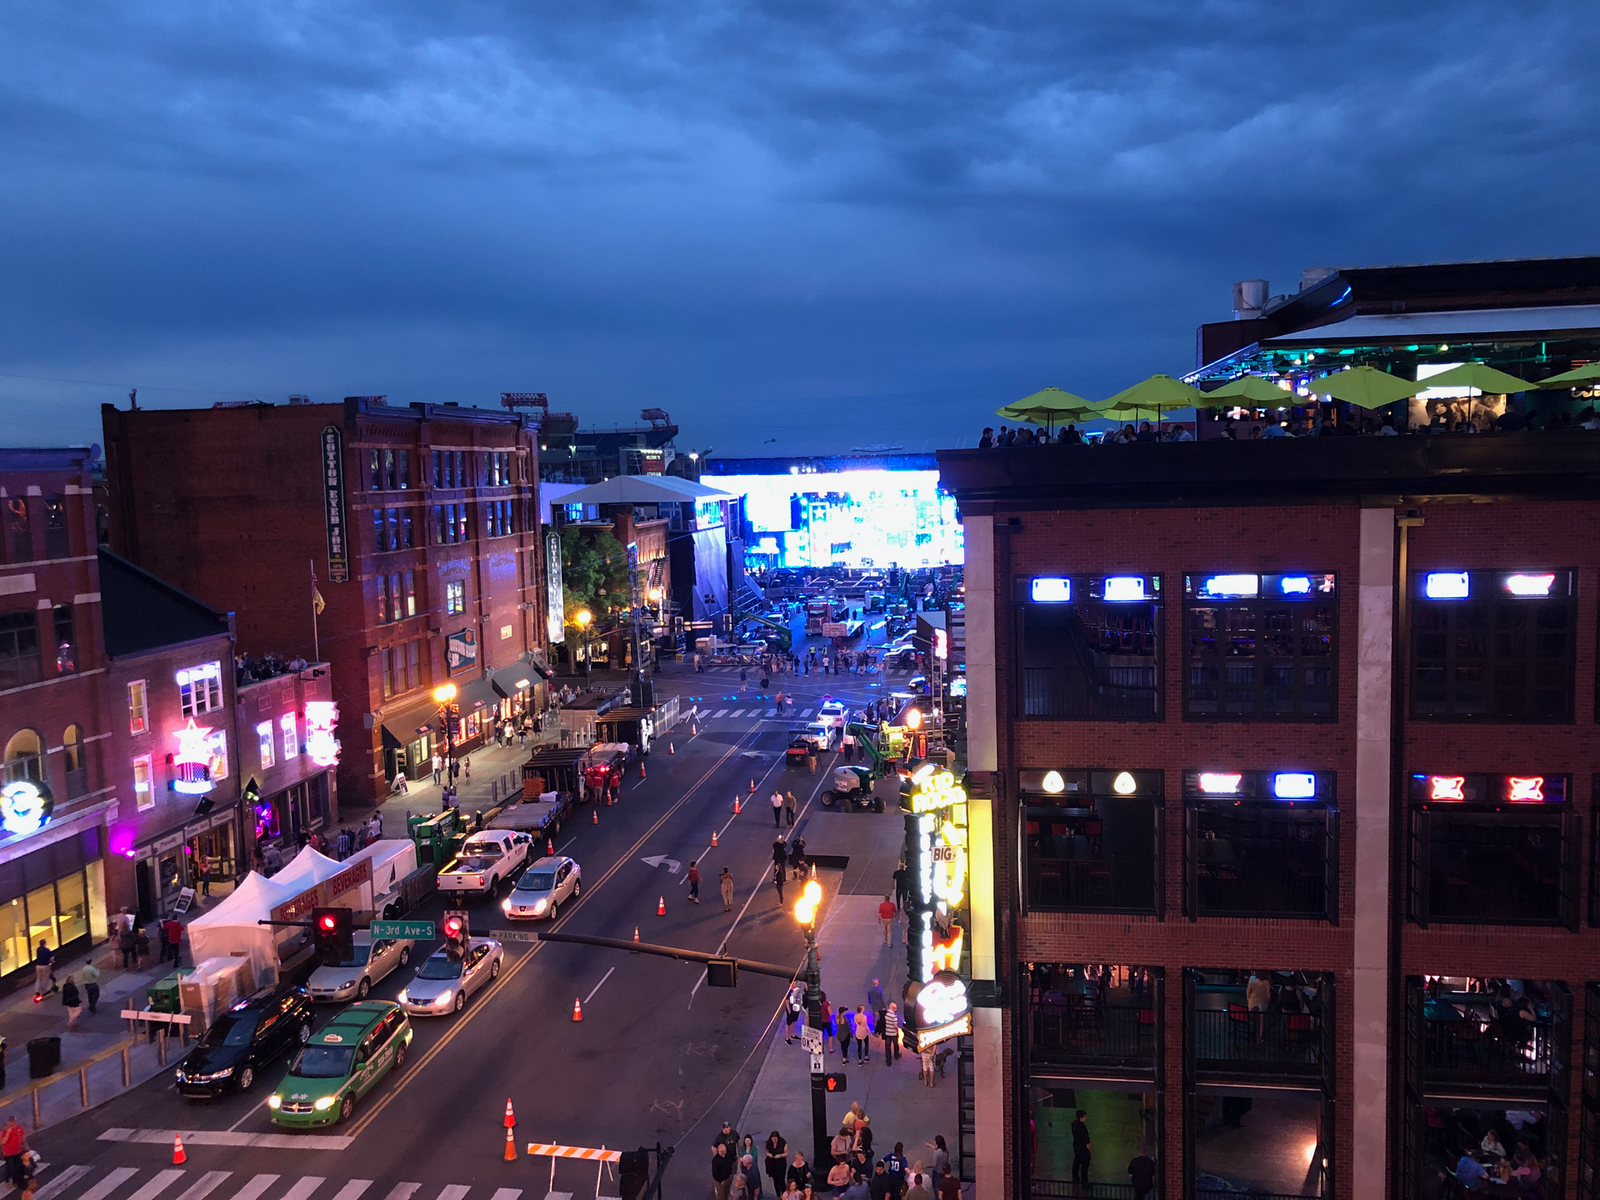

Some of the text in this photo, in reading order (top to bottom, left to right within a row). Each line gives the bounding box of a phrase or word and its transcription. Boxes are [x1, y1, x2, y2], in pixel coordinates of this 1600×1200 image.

[326, 434, 338, 486] COTTON
[329, 490, 340, 525] EYED
[331, 527, 341, 553] JOE
[921, 772, 954, 793] KID
[933, 847, 952, 862] BIG
[332, 862, 368, 896] BEVERAGES
[280, 889, 319, 922] BEVERAGES
[498, 932, 529, 941] PARKING
[890, 1160, 900, 1172] 10
